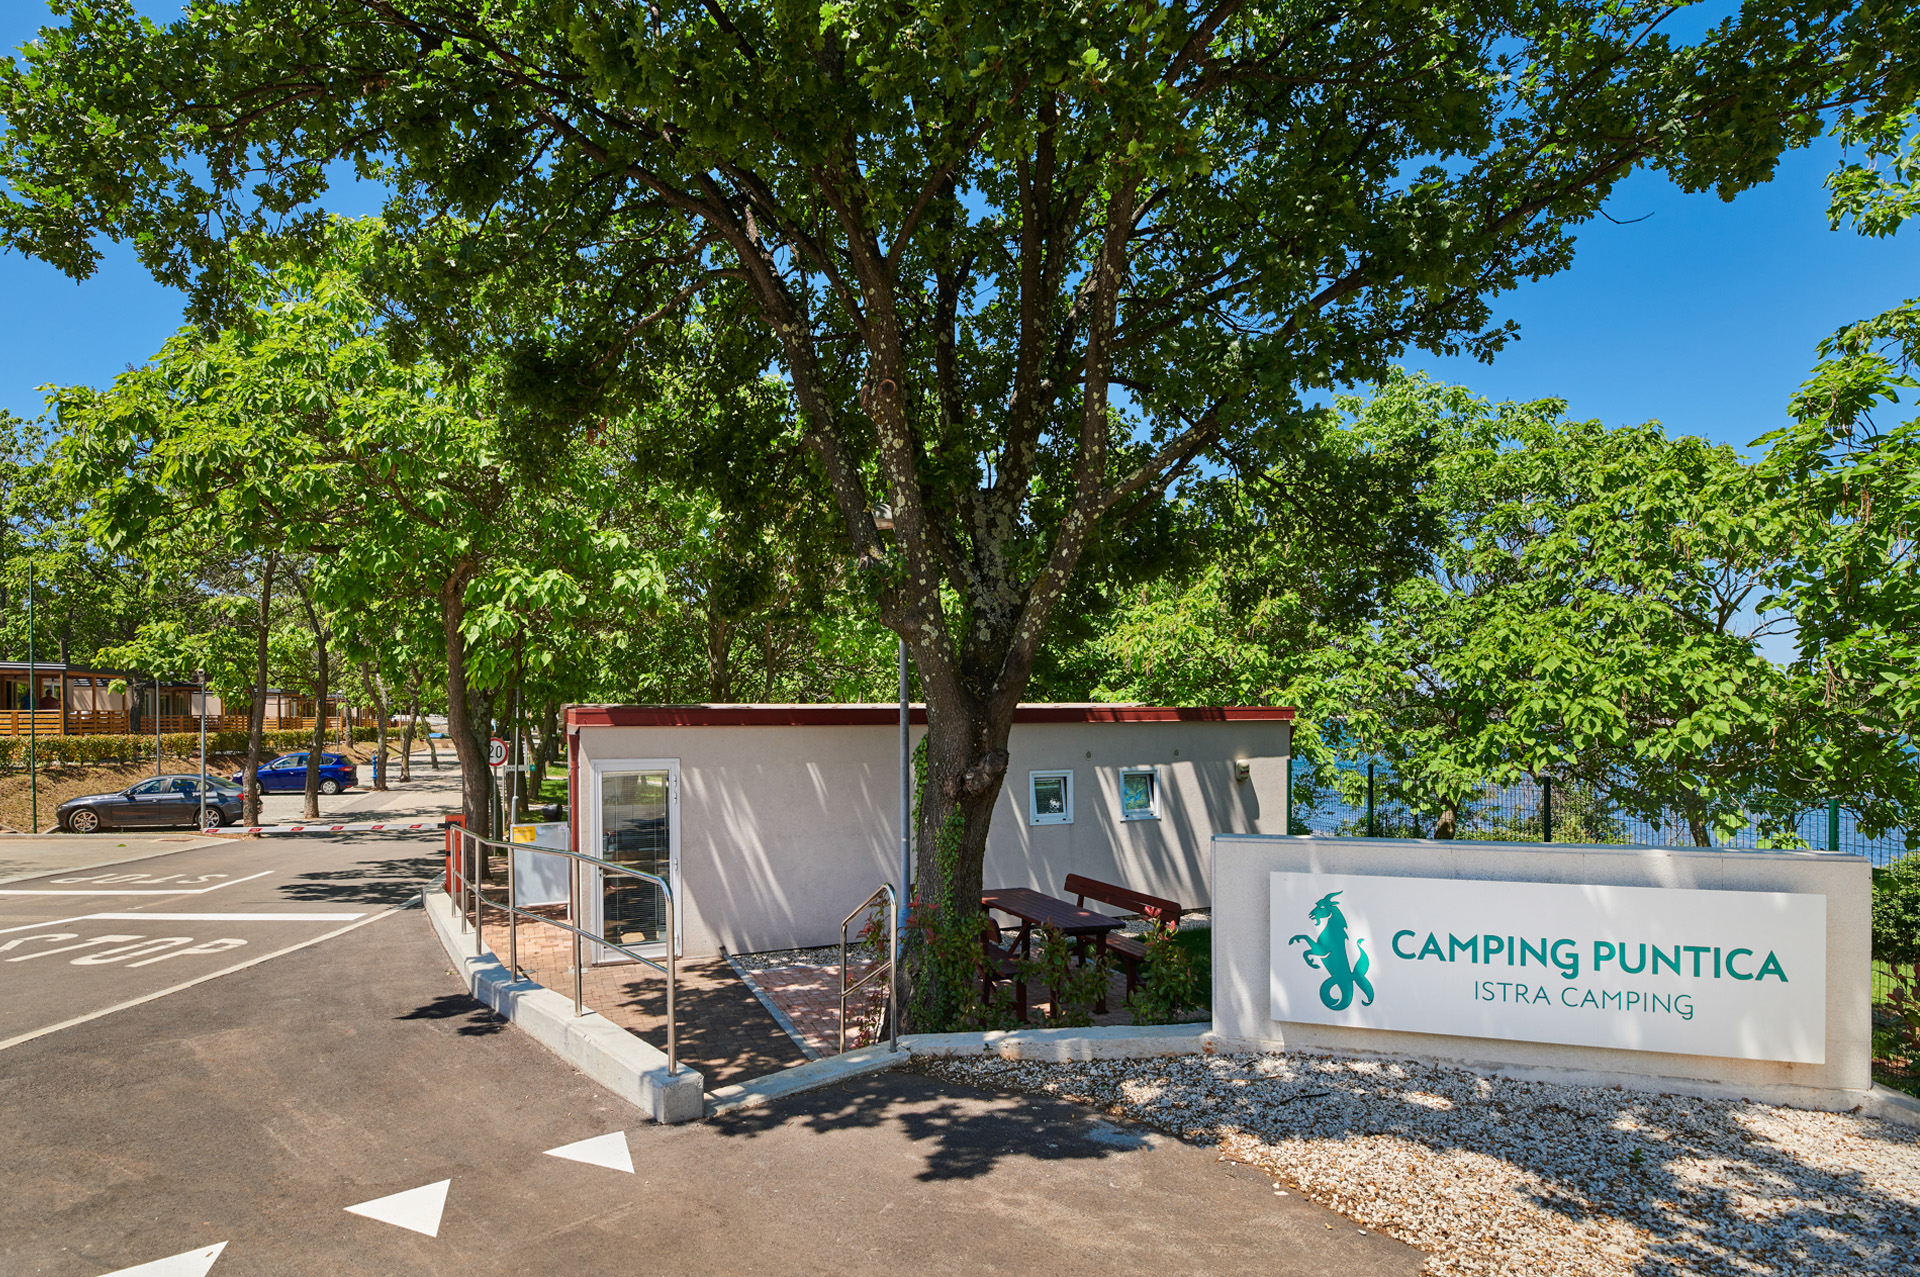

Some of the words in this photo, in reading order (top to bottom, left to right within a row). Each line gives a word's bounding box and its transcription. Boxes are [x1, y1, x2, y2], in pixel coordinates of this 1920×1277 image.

[490, 745, 502, 758] 20
[1391, 929, 1581, 980] CAMPING
[1593, 940, 1790, 984] PUNTICA
[1474, 980, 1552, 1006] ISTRA
[1560, 986, 1695, 1022] CAMPING
